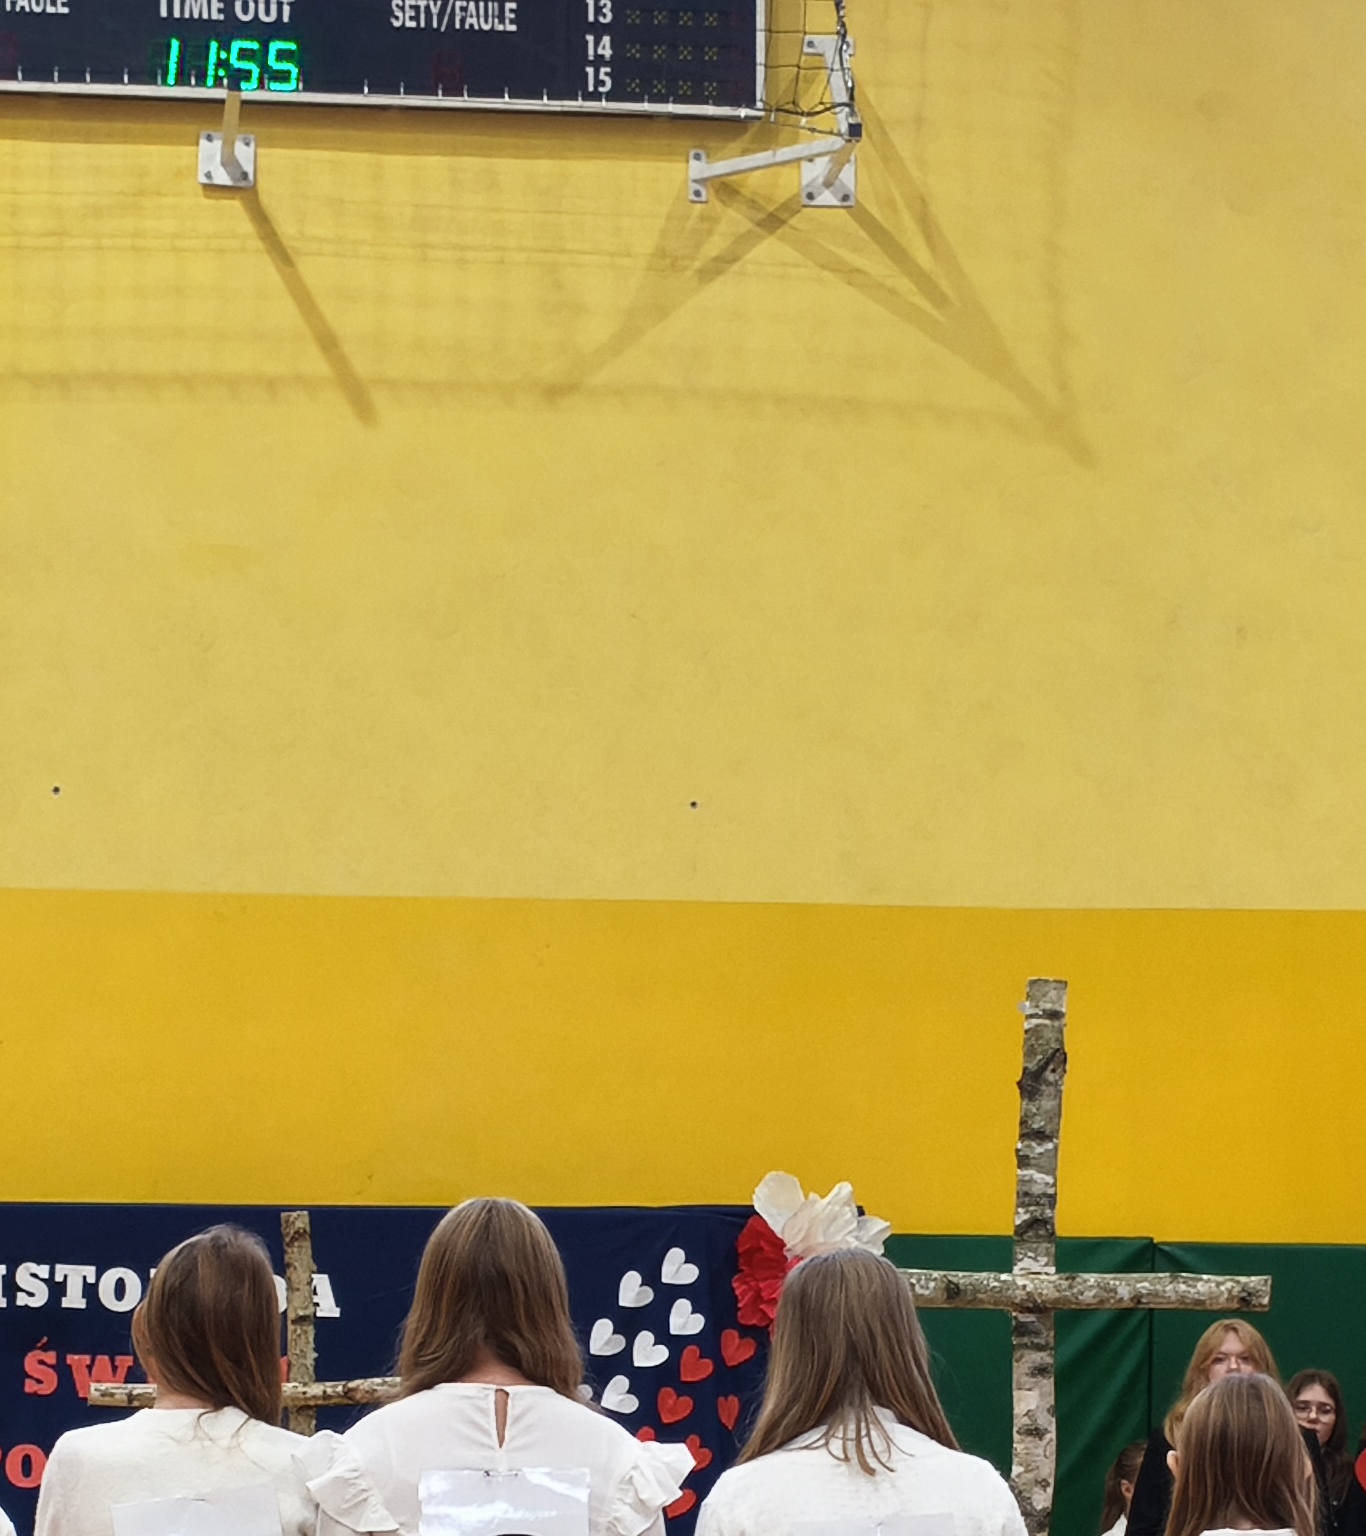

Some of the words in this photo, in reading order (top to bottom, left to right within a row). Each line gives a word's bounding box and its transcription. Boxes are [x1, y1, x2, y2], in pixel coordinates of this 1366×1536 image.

[159, 0, 225, 20] TIME
[234, 0, 295, 23] OUT
[390, 0, 517, 32] SETY/FAULE
[585, 0, 613, 24] 13
[585, 34, 613, 61] 14
[167, 38, 299, 91] 11:55
[585, 66, 613, 93] 15
